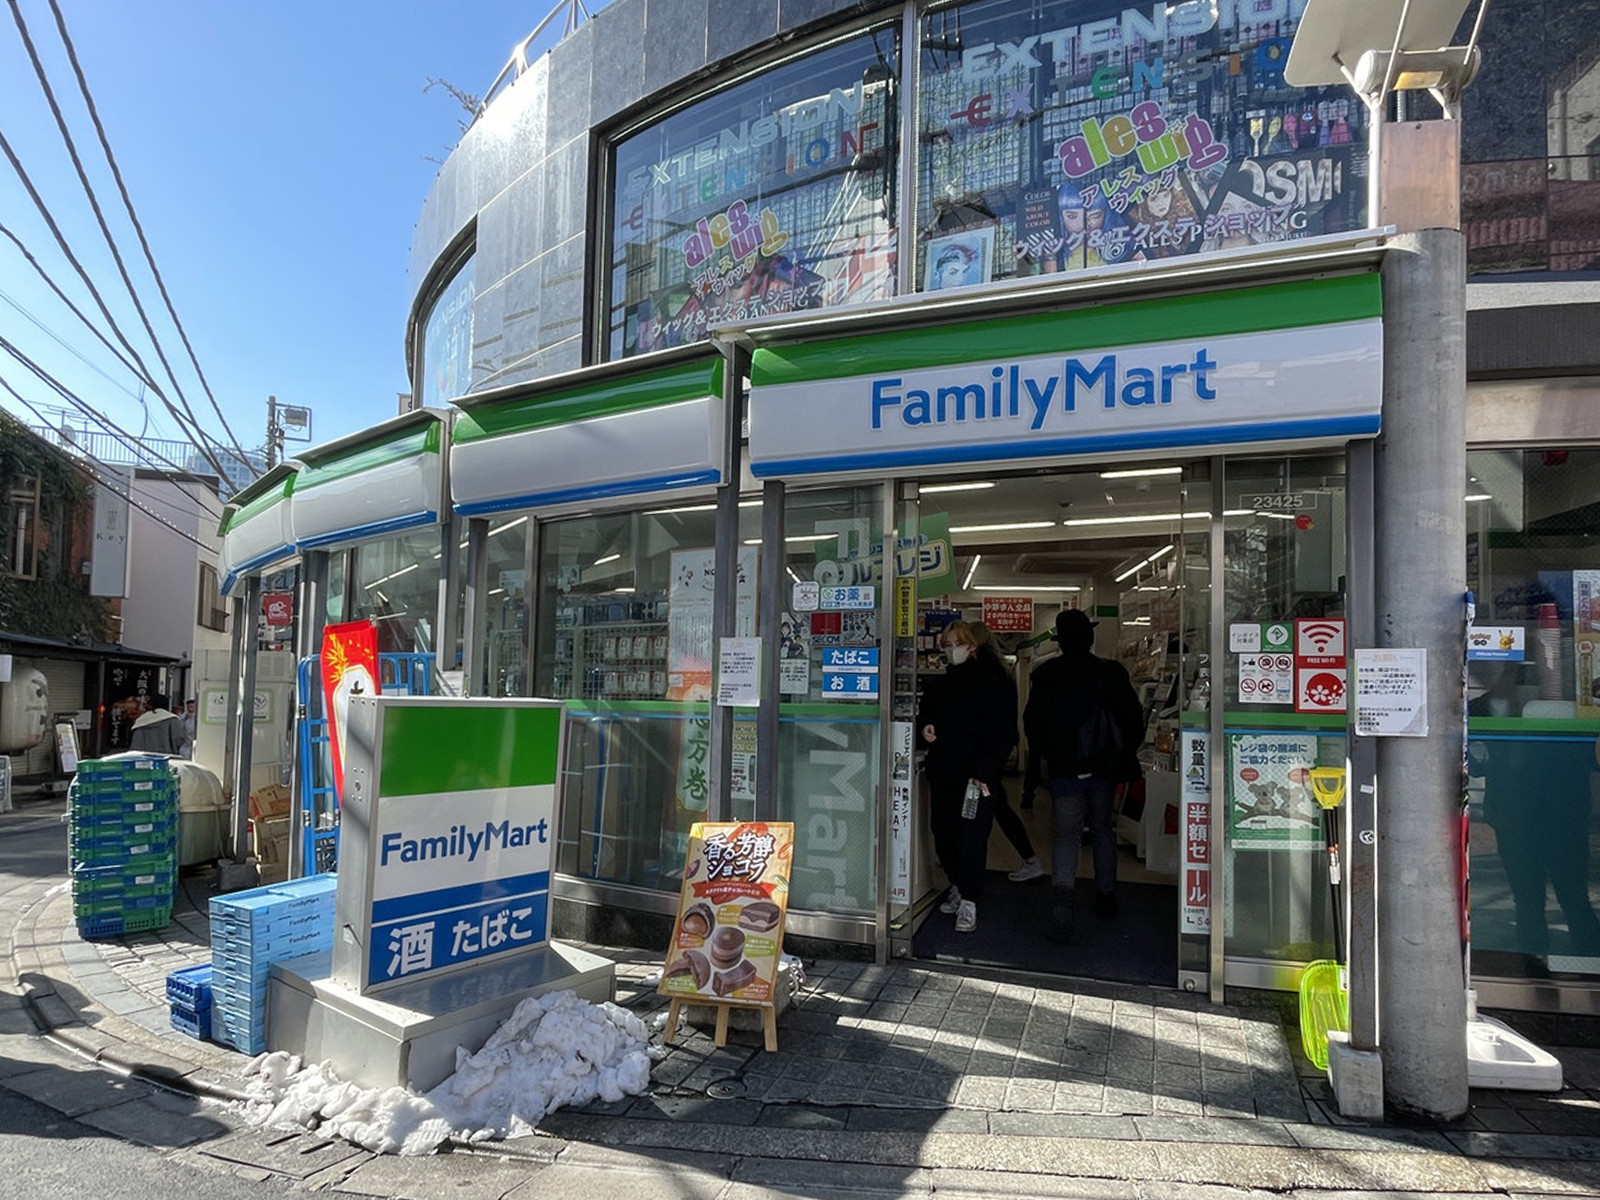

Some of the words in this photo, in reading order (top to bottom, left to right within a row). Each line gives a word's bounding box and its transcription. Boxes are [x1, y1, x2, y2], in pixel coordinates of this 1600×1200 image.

[962, 0, 1306, 82] EXTENSIO
[1058, 100, 1168, 179] ales
[1079, 166, 1141, 208] アレス
[871, 348, 1217, 430] FamilyMart
[1253, 495, 1303, 509] 23425
[831, 650, 869, 664] たばこ
[831, 675, 870, 691] お酒
[1240, 743, 1308, 753] レジ袋の削減に
[1240, 754, 1312, 765] ご協力ください。
[380, 818, 548, 866] FamilyMart
[1189, 803, 1207, 902] 半額セール
[707, 858, 766, 882] ショコラ
[387, 921, 435, 976] 酒
[451, 907, 533, 957] たばこ
